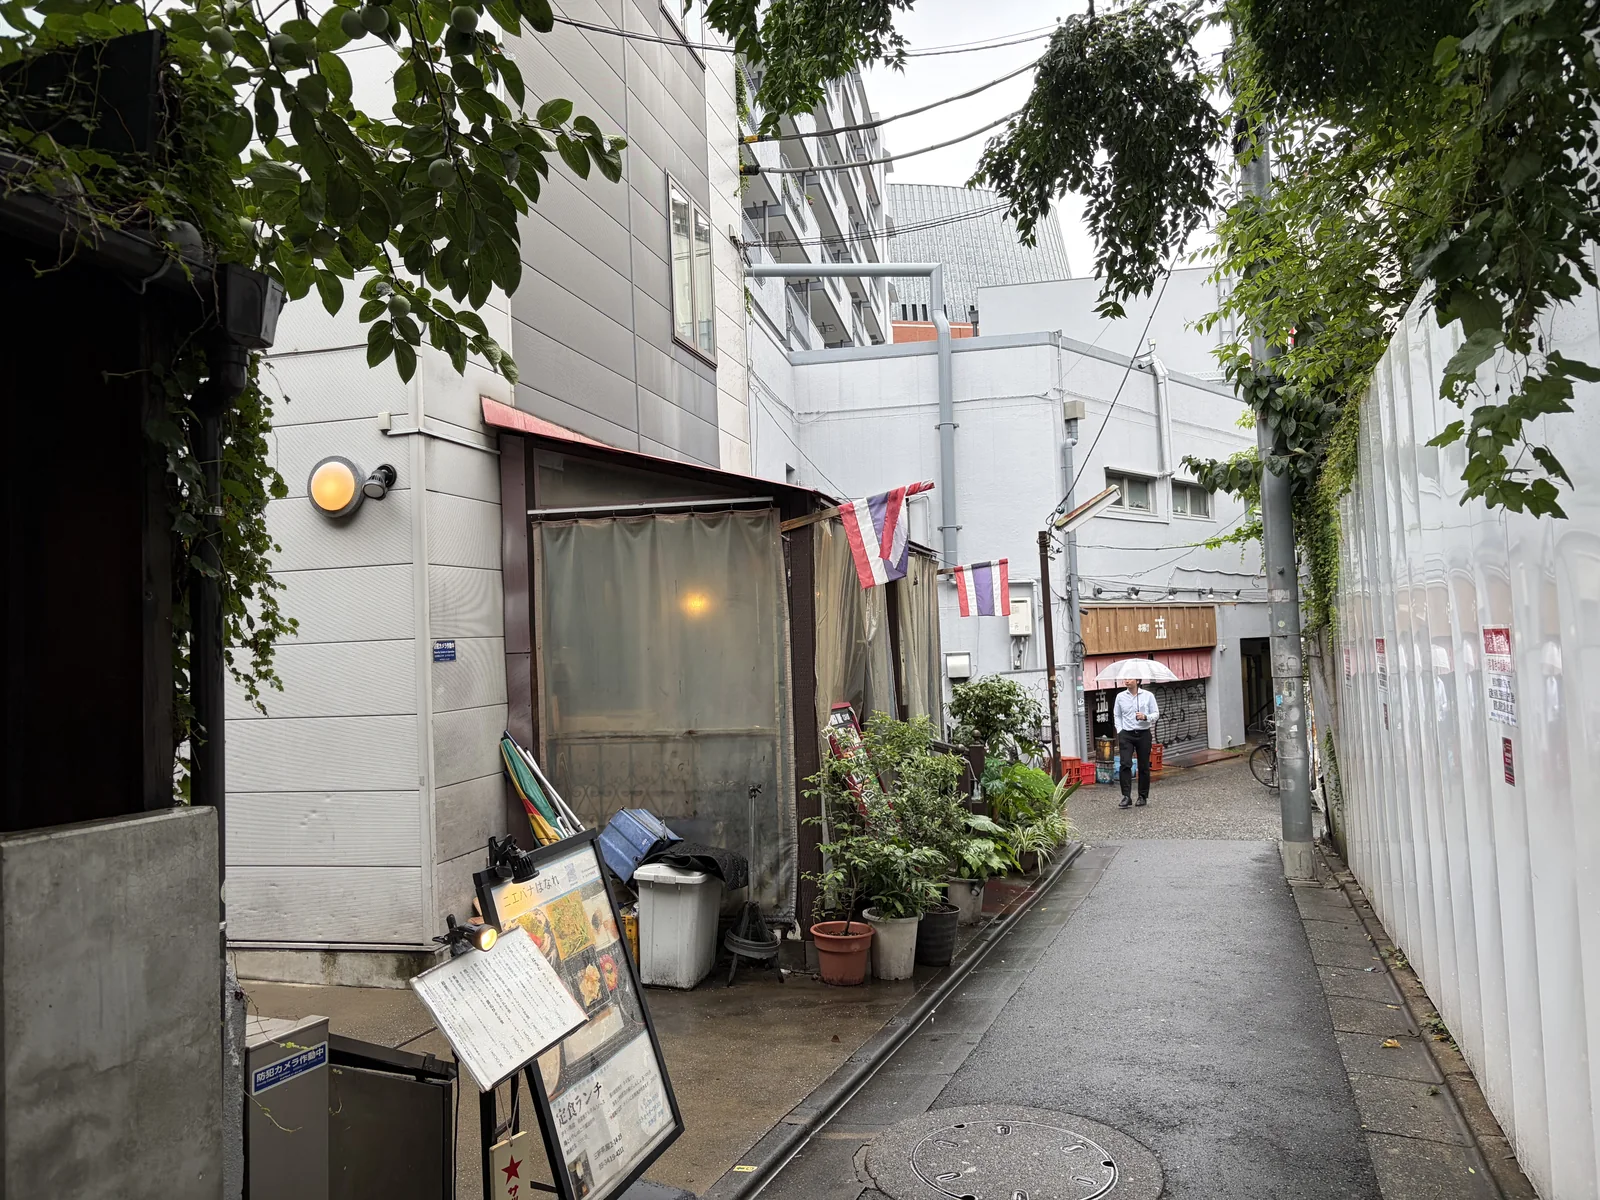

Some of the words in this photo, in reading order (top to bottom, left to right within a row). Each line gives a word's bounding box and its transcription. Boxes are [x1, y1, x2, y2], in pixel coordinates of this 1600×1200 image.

[503, 875, 560, 908] ニエバナはなれ
[256, 1047, 324, 1083] 防犯カメラ作動中
[556, 1081, 602, 1128] 定食ランチ
